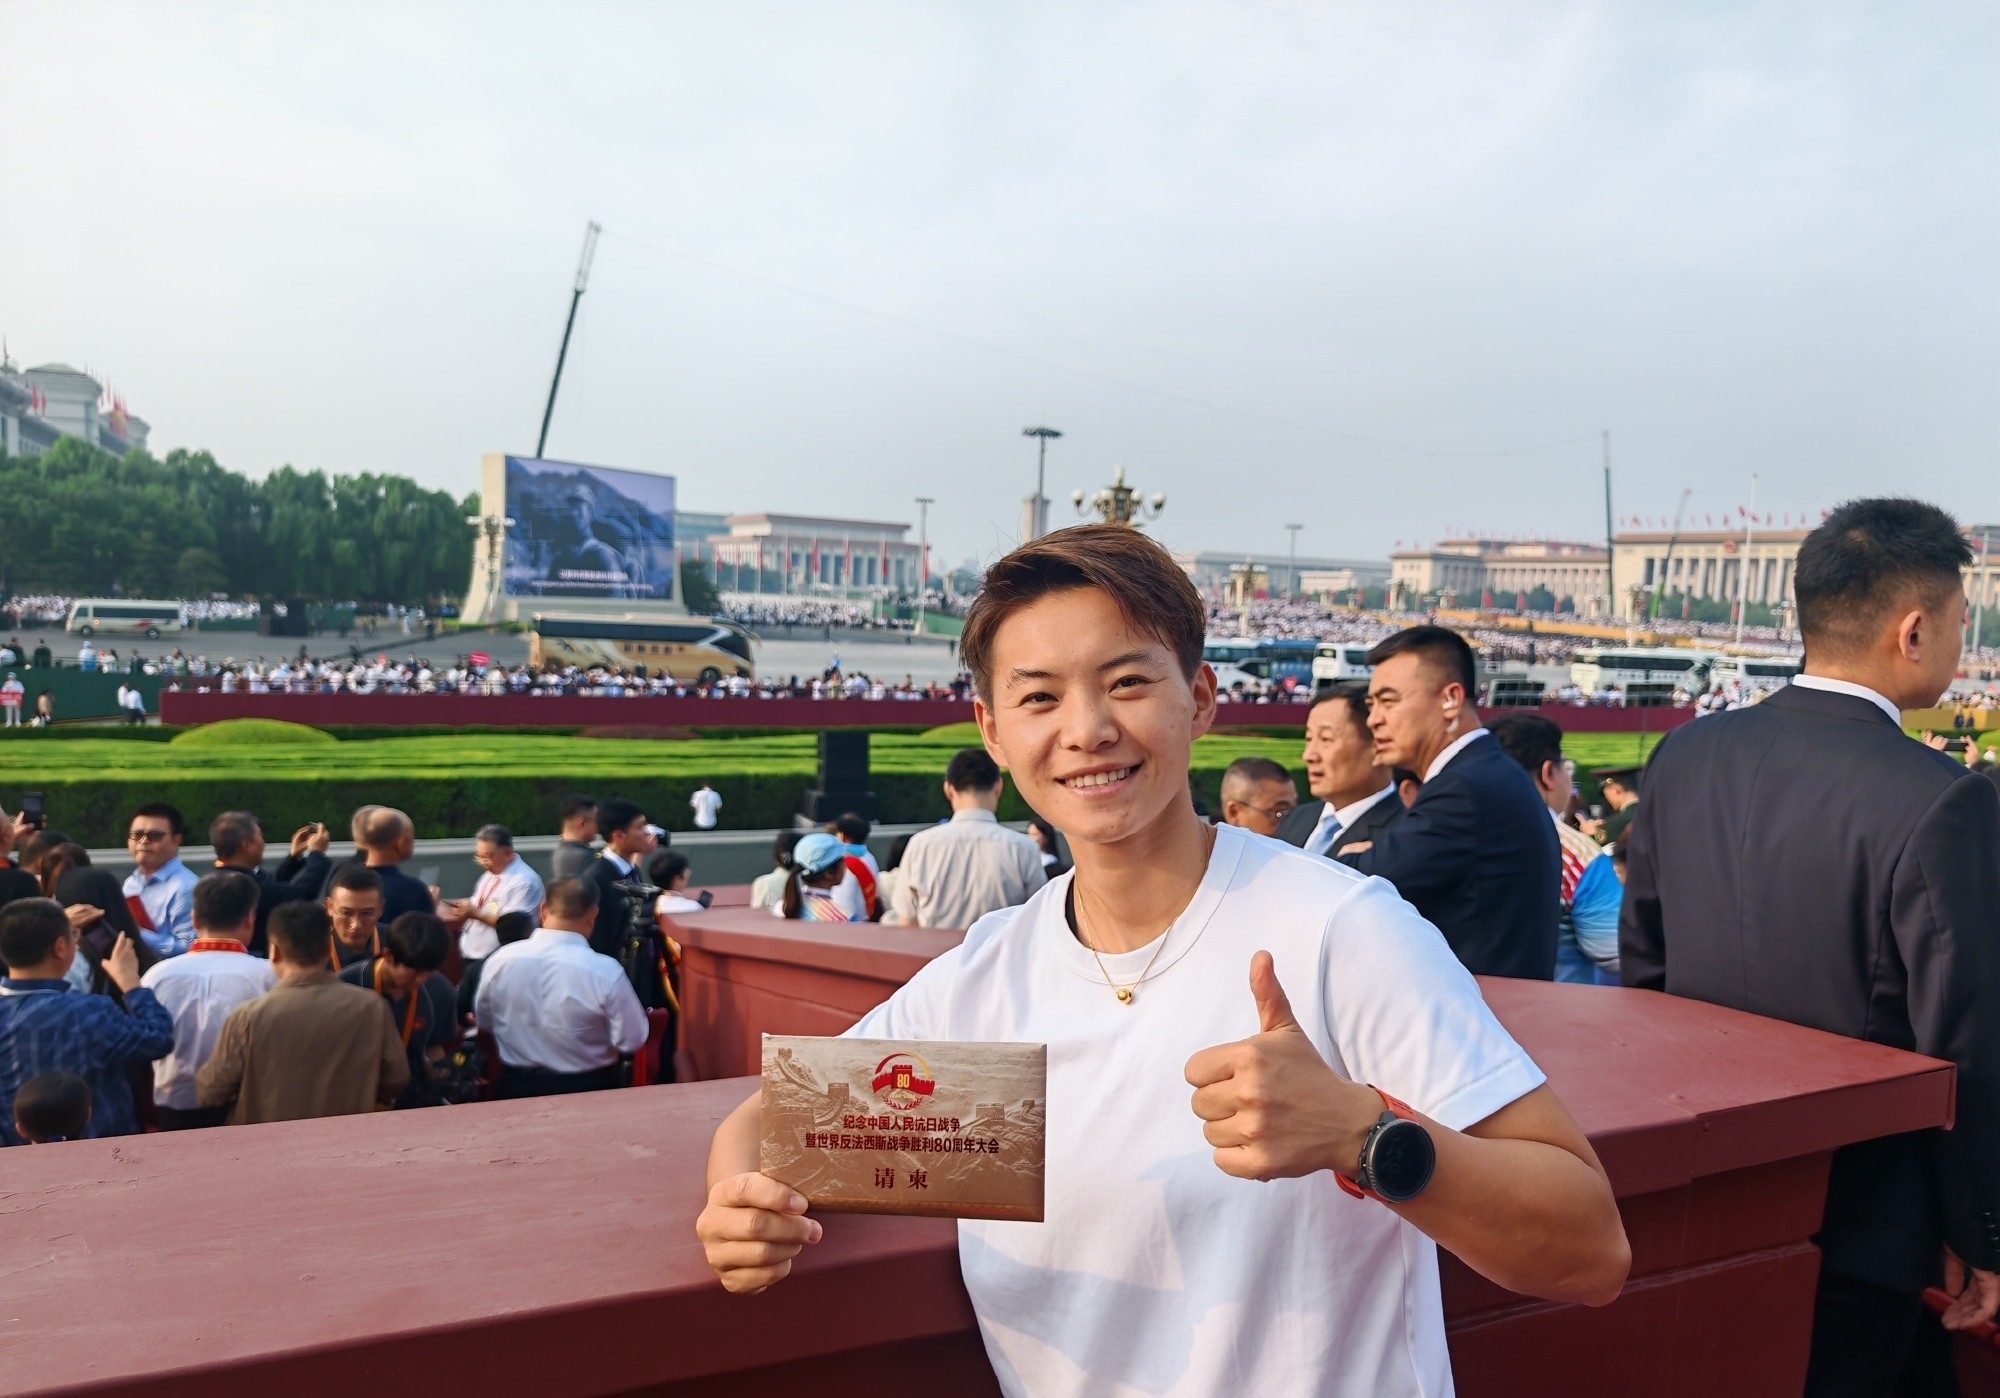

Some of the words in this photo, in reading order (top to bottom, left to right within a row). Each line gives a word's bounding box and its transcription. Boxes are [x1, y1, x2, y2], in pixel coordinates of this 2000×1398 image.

[897, 1073, 910, 1088] 80
[843, 1114, 961, 1132] 纪念中国人民抗日战争
[805, 1133, 1000, 1154] 暨世界反法西斯战争胜利80周年大会
[874, 1167, 929, 1190] 请柬
